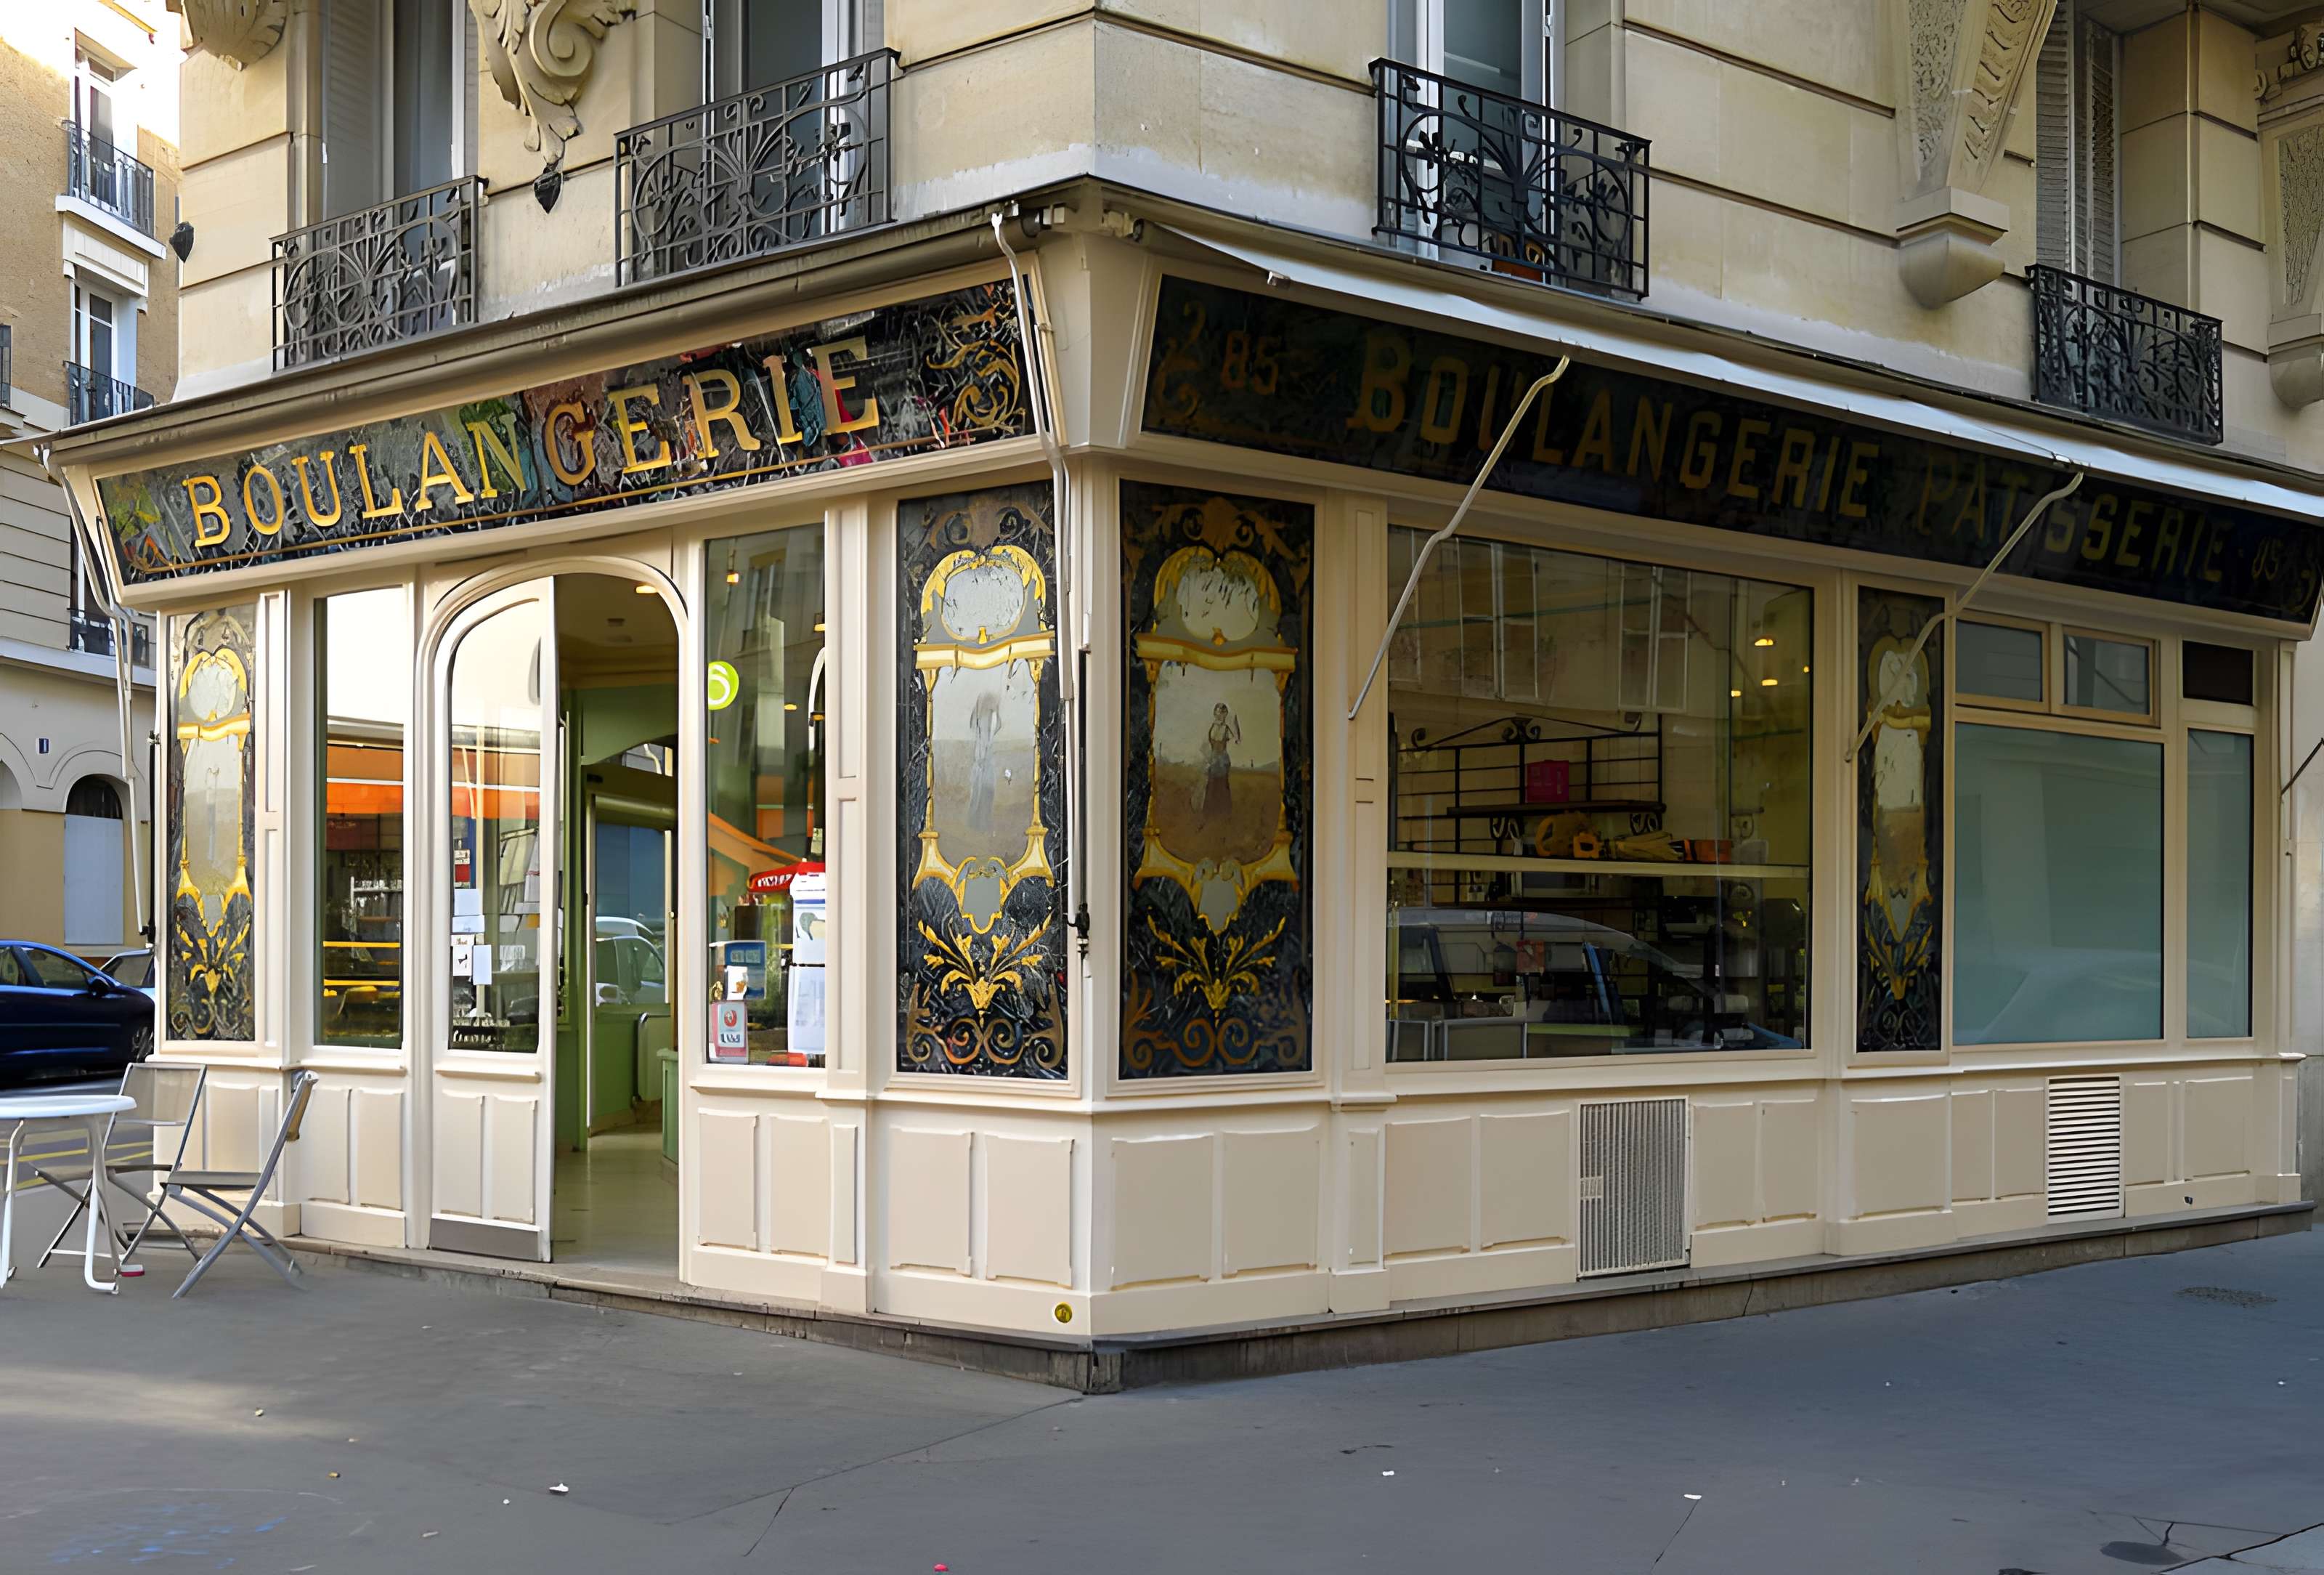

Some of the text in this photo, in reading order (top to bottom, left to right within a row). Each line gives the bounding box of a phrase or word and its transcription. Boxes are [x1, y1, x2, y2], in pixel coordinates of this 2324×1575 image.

[181, 336, 880, 547] BOULANGERIE
[1346, 326, 1881, 519] BOULANGERIE
[1917, 449, 2235, 583] PATSSERIE
